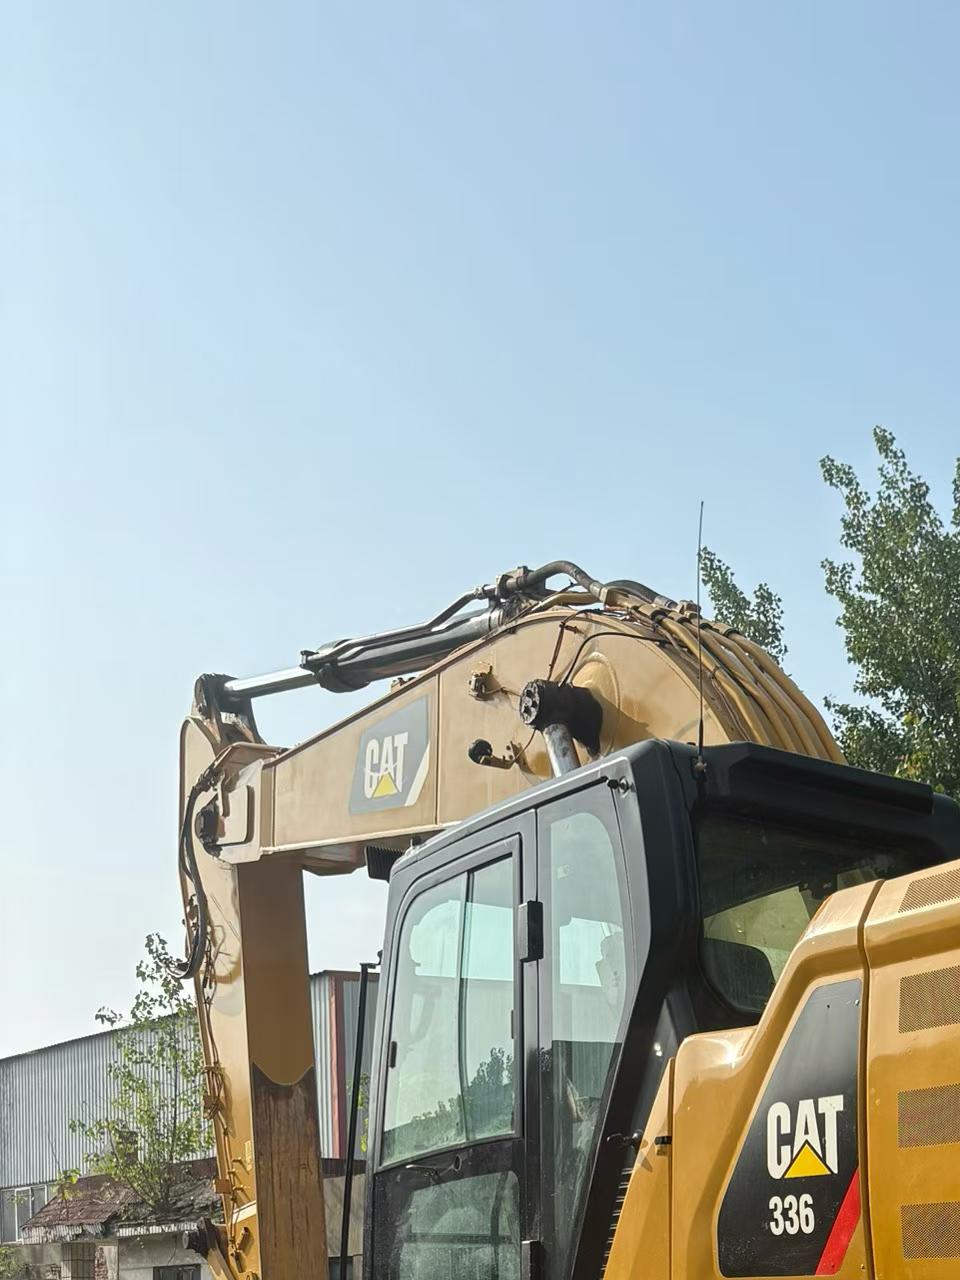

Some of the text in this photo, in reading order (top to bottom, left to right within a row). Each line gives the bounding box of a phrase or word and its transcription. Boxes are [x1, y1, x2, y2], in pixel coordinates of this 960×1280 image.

[364, 732, 409, 799] CAT
[766, 1094, 844, 1180] CAT
[768, 1193, 815, 1236] 336
